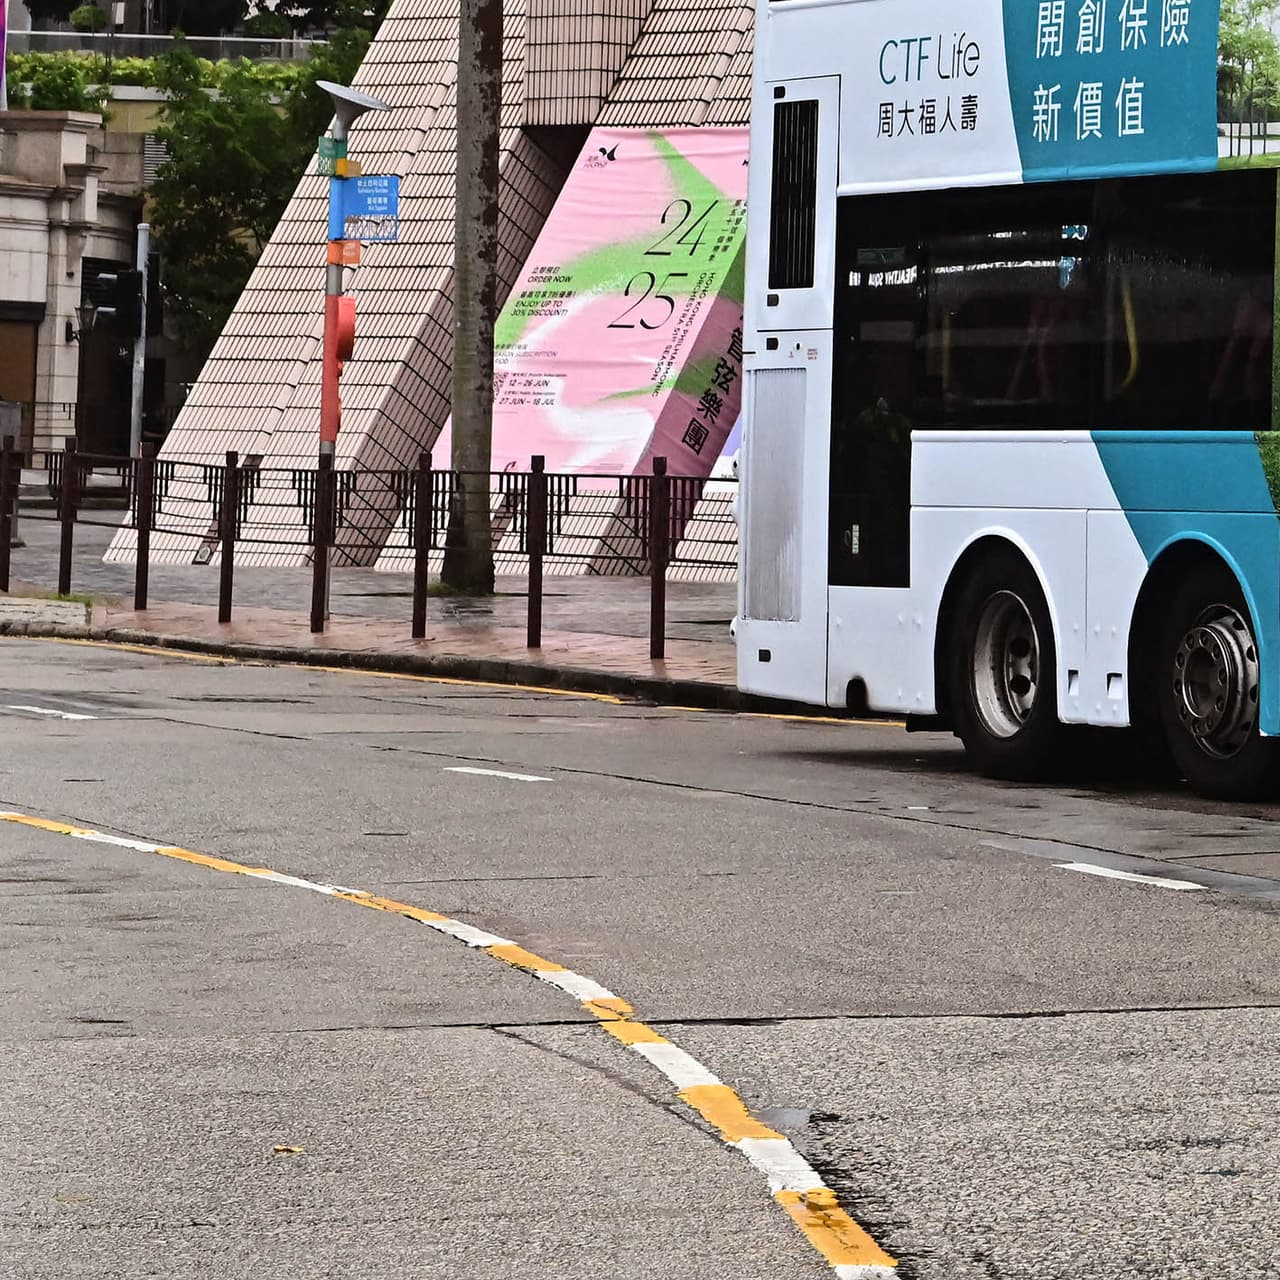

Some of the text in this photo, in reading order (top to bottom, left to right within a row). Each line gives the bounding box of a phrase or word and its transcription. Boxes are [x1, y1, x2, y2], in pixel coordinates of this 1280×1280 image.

[878, 32, 980, 85] CTF Life
[877, 94, 979, 139] 周大福人壽
[1032, 77, 1146, 143] 新價值
[643, 199, 719, 256] 24
[607, 272, 688, 330] 25
[682, 316, 744, 455] 管弦樂團
